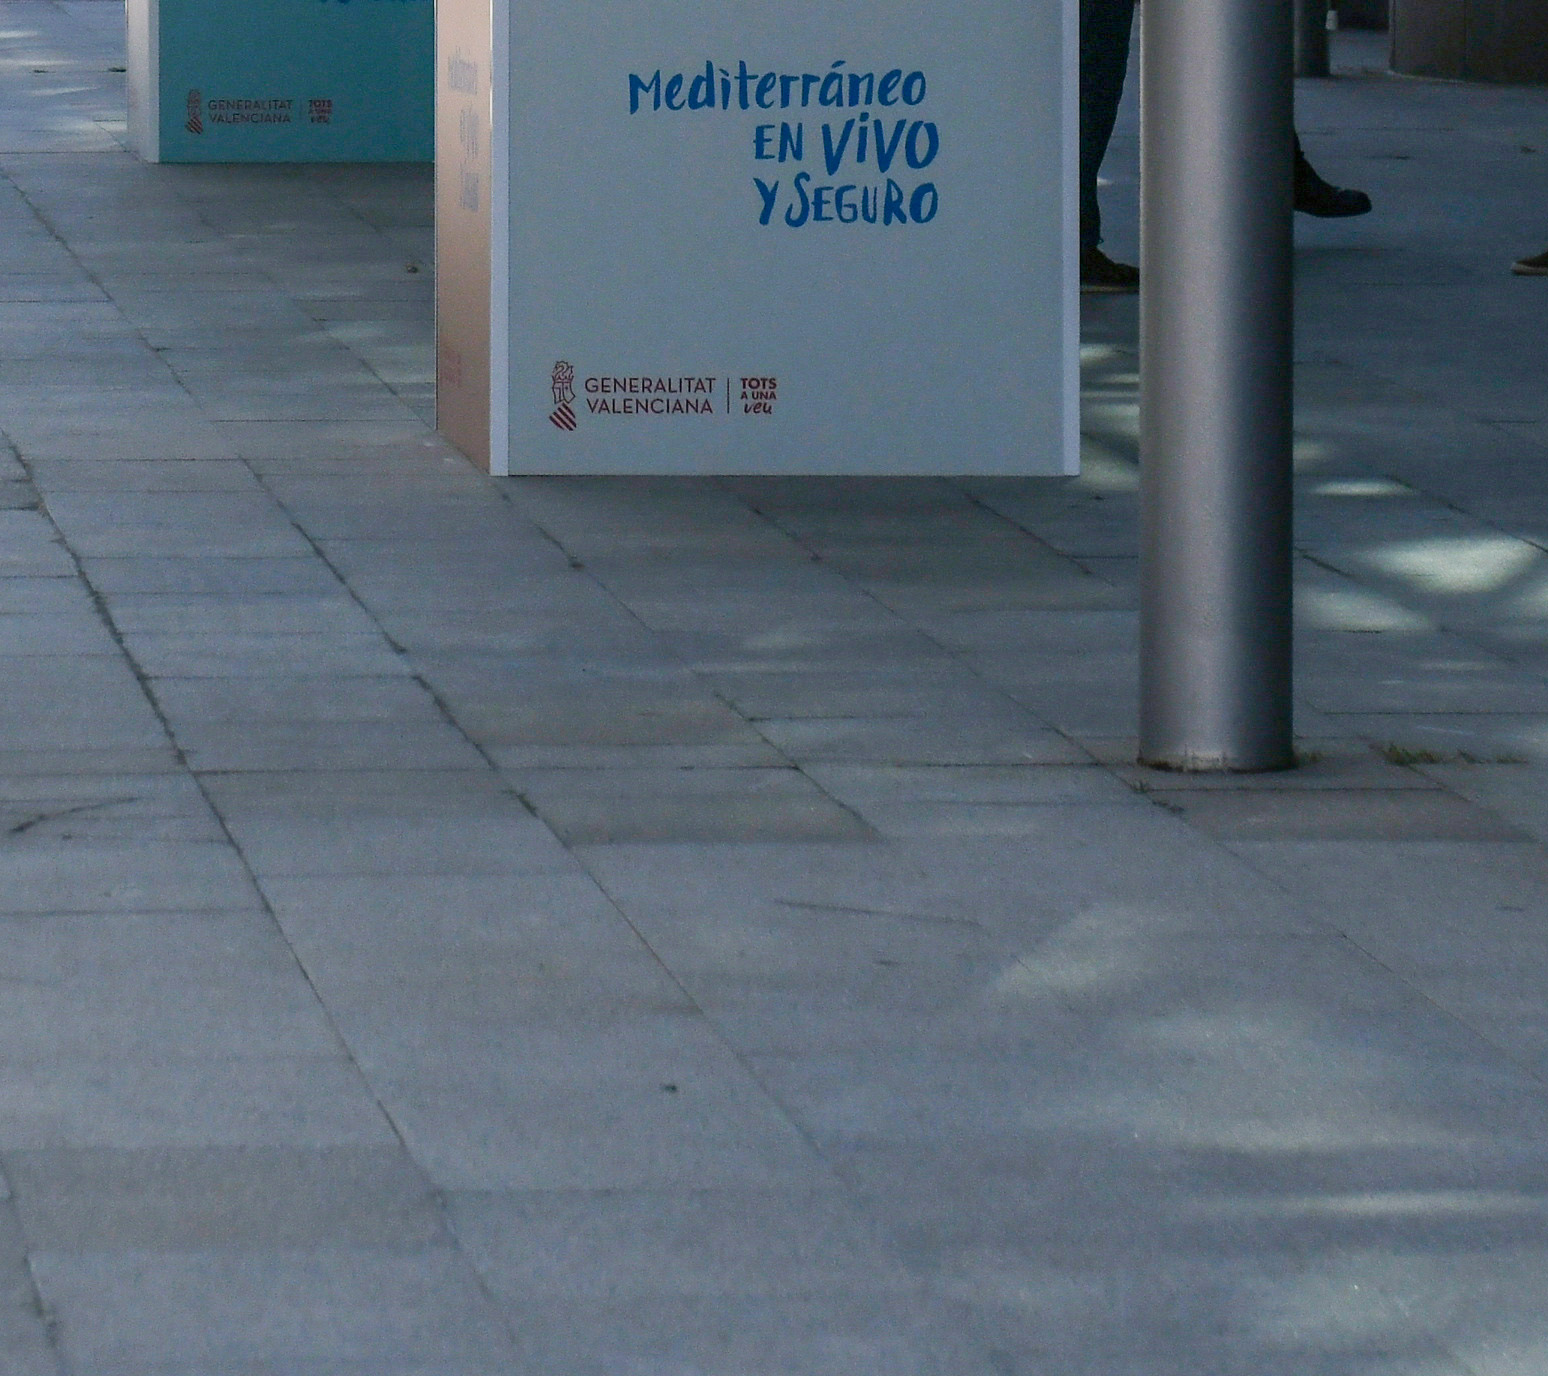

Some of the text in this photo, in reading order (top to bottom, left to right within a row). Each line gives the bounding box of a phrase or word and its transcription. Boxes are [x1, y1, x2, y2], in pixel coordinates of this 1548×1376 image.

[629, 59, 927, 114] Mediterráneo
[208, 99, 294, 111] GENERALITAT
[210, 114, 292, 124] VALENCIANA
[753, 122, 803, 162] EN
[752, 177, 778, 226] Y
[584, 376, 716, 395] GENERALITAT
[740, 377, 777, 389] TOTS
[741, 391, 777, 401] A UNA
[585, 397, 713, 415] VALENCIANA
